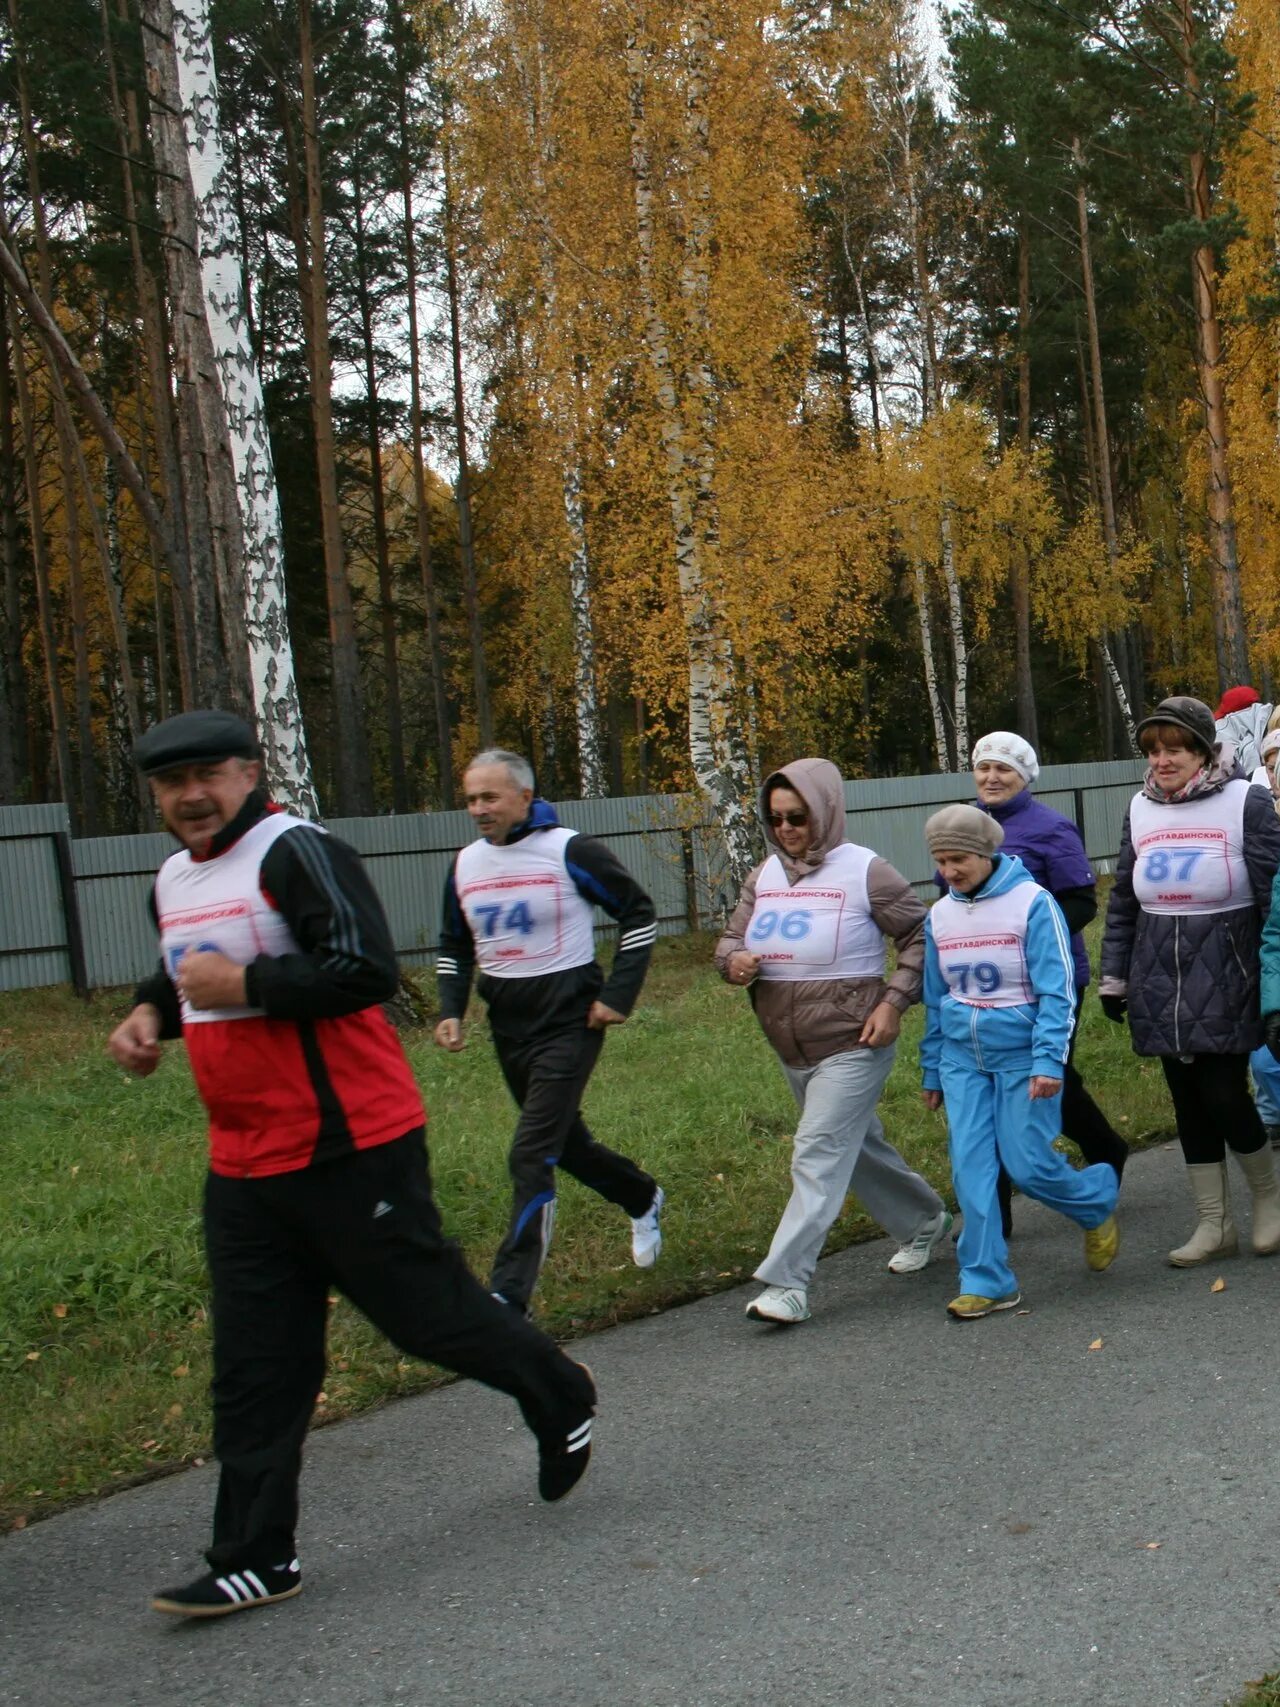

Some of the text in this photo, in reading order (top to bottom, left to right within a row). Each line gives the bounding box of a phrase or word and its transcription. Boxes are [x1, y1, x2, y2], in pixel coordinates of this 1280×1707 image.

[1144, 849, 1202, 882] 87
[758, 891, 842, 899] ЖНЕТАВДИНСКИЙ
[474, 900, 535, 937] 74
[750, 909, 812, 941] 96
[761, 952, 793, 961] РАЙОН
[938, 937, 1017, 950] ЖНЕТАВДИНСКИЙ
[946, 962, 1002, 995] 79
